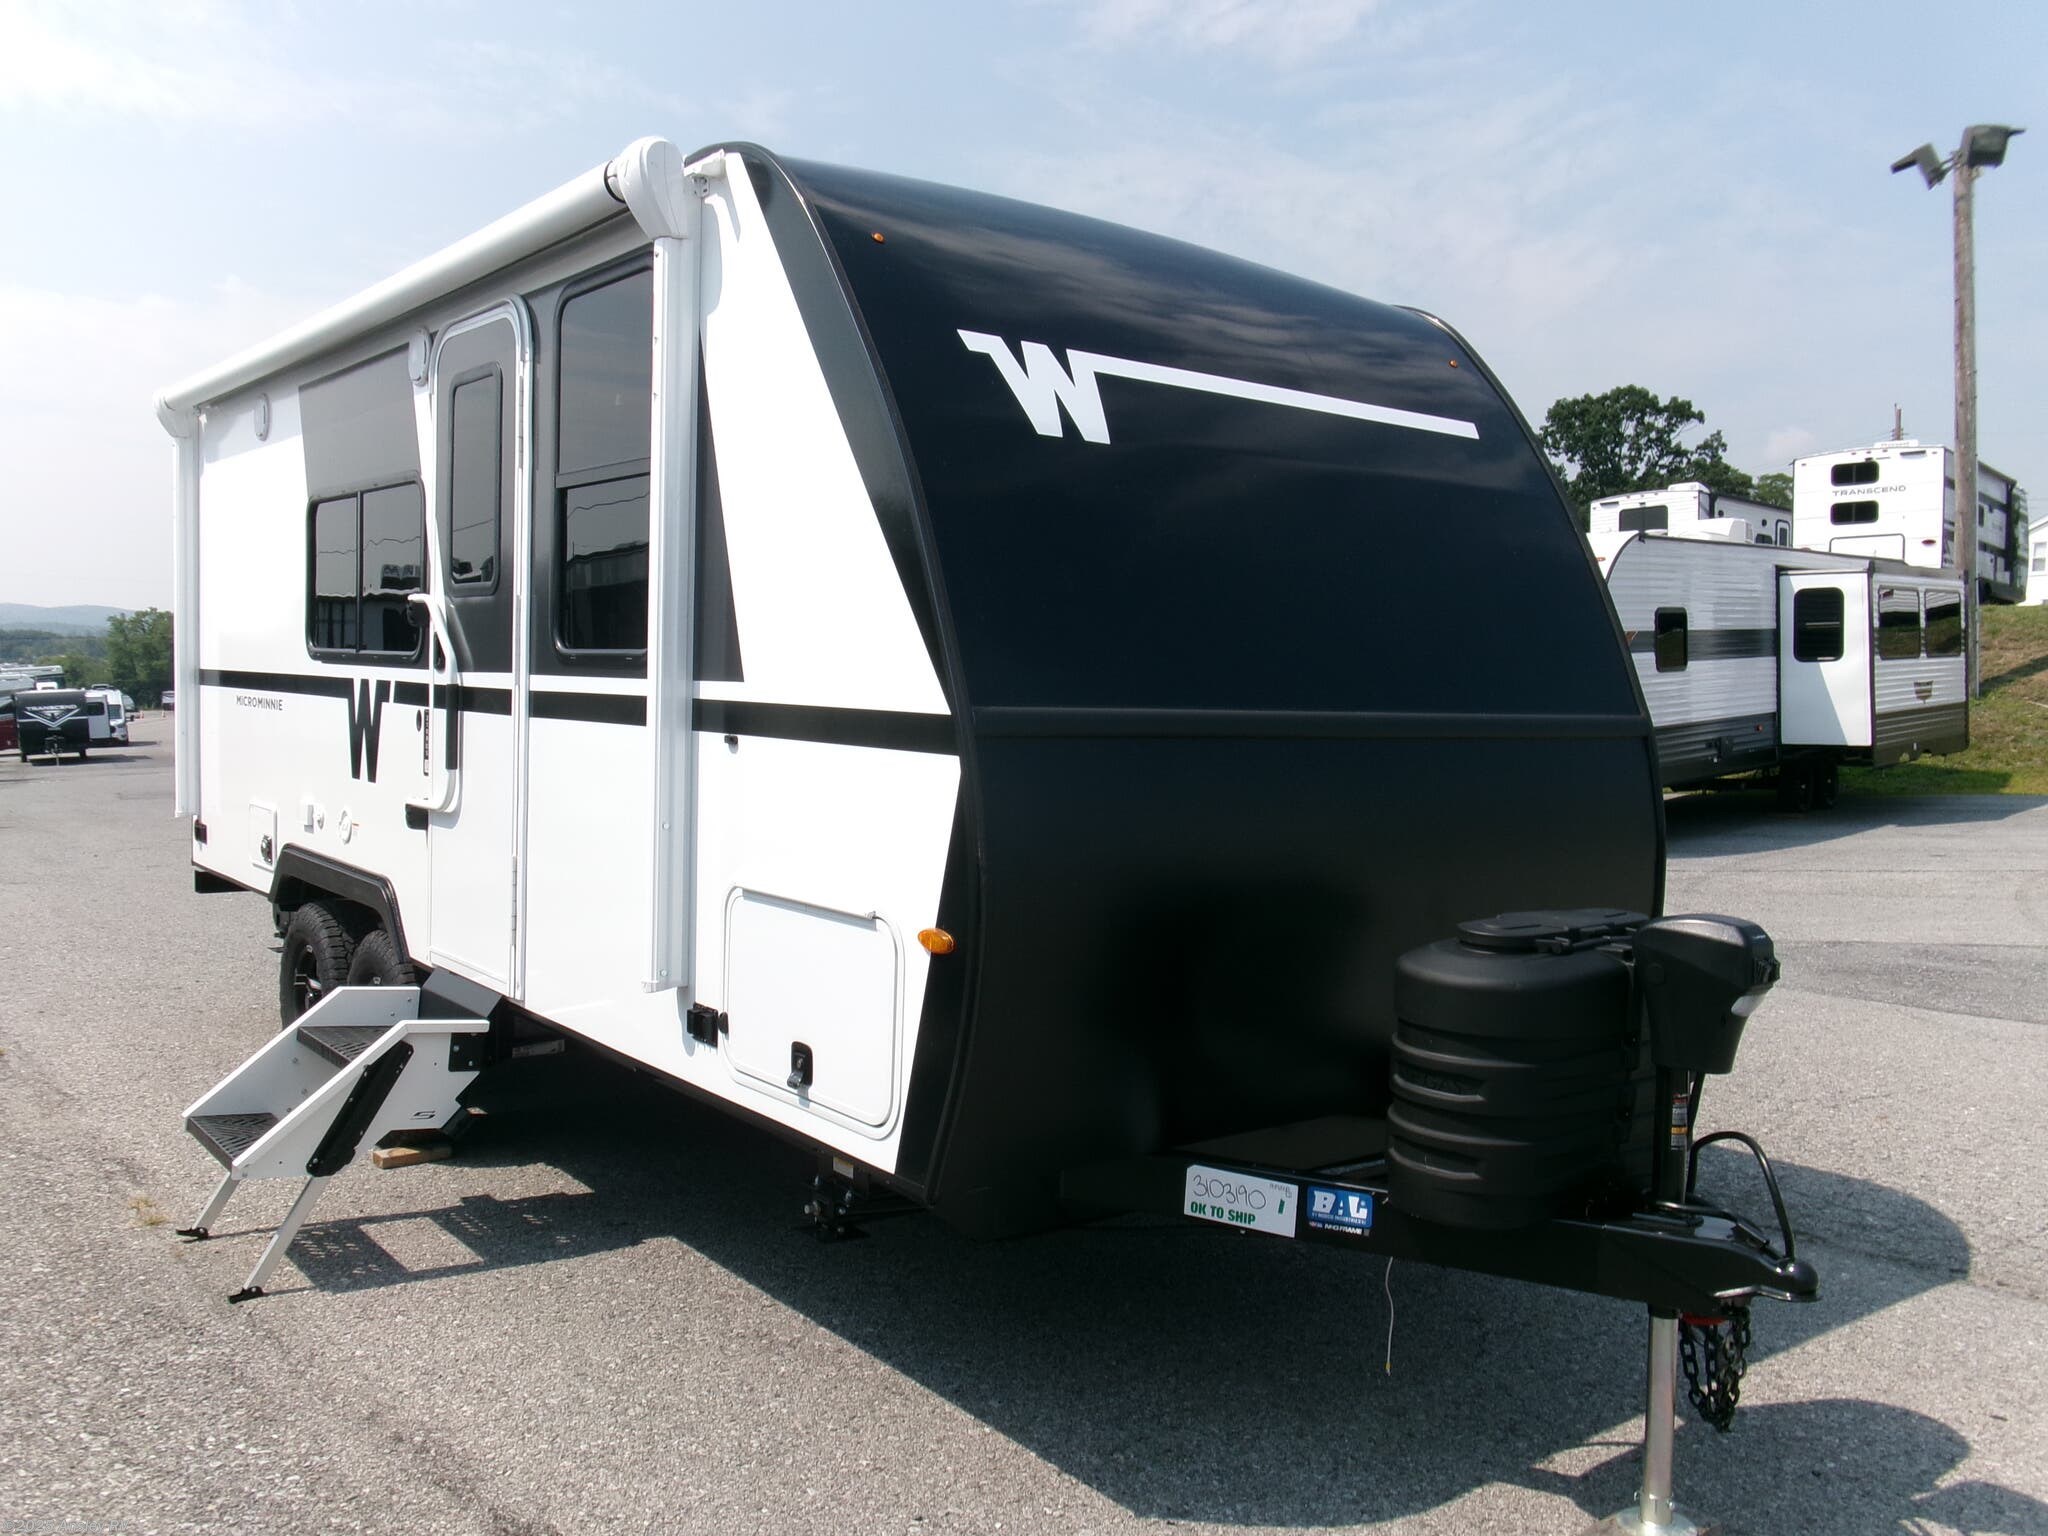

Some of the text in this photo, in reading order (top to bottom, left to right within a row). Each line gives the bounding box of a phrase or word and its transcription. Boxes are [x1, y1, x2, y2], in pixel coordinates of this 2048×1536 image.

[1832, 484, 1907, 497] TRANSCEND
[235, 694, 284, 711] MICROMINNIE
[1190, 1201, 1256, 1225] OK TO SHIP
